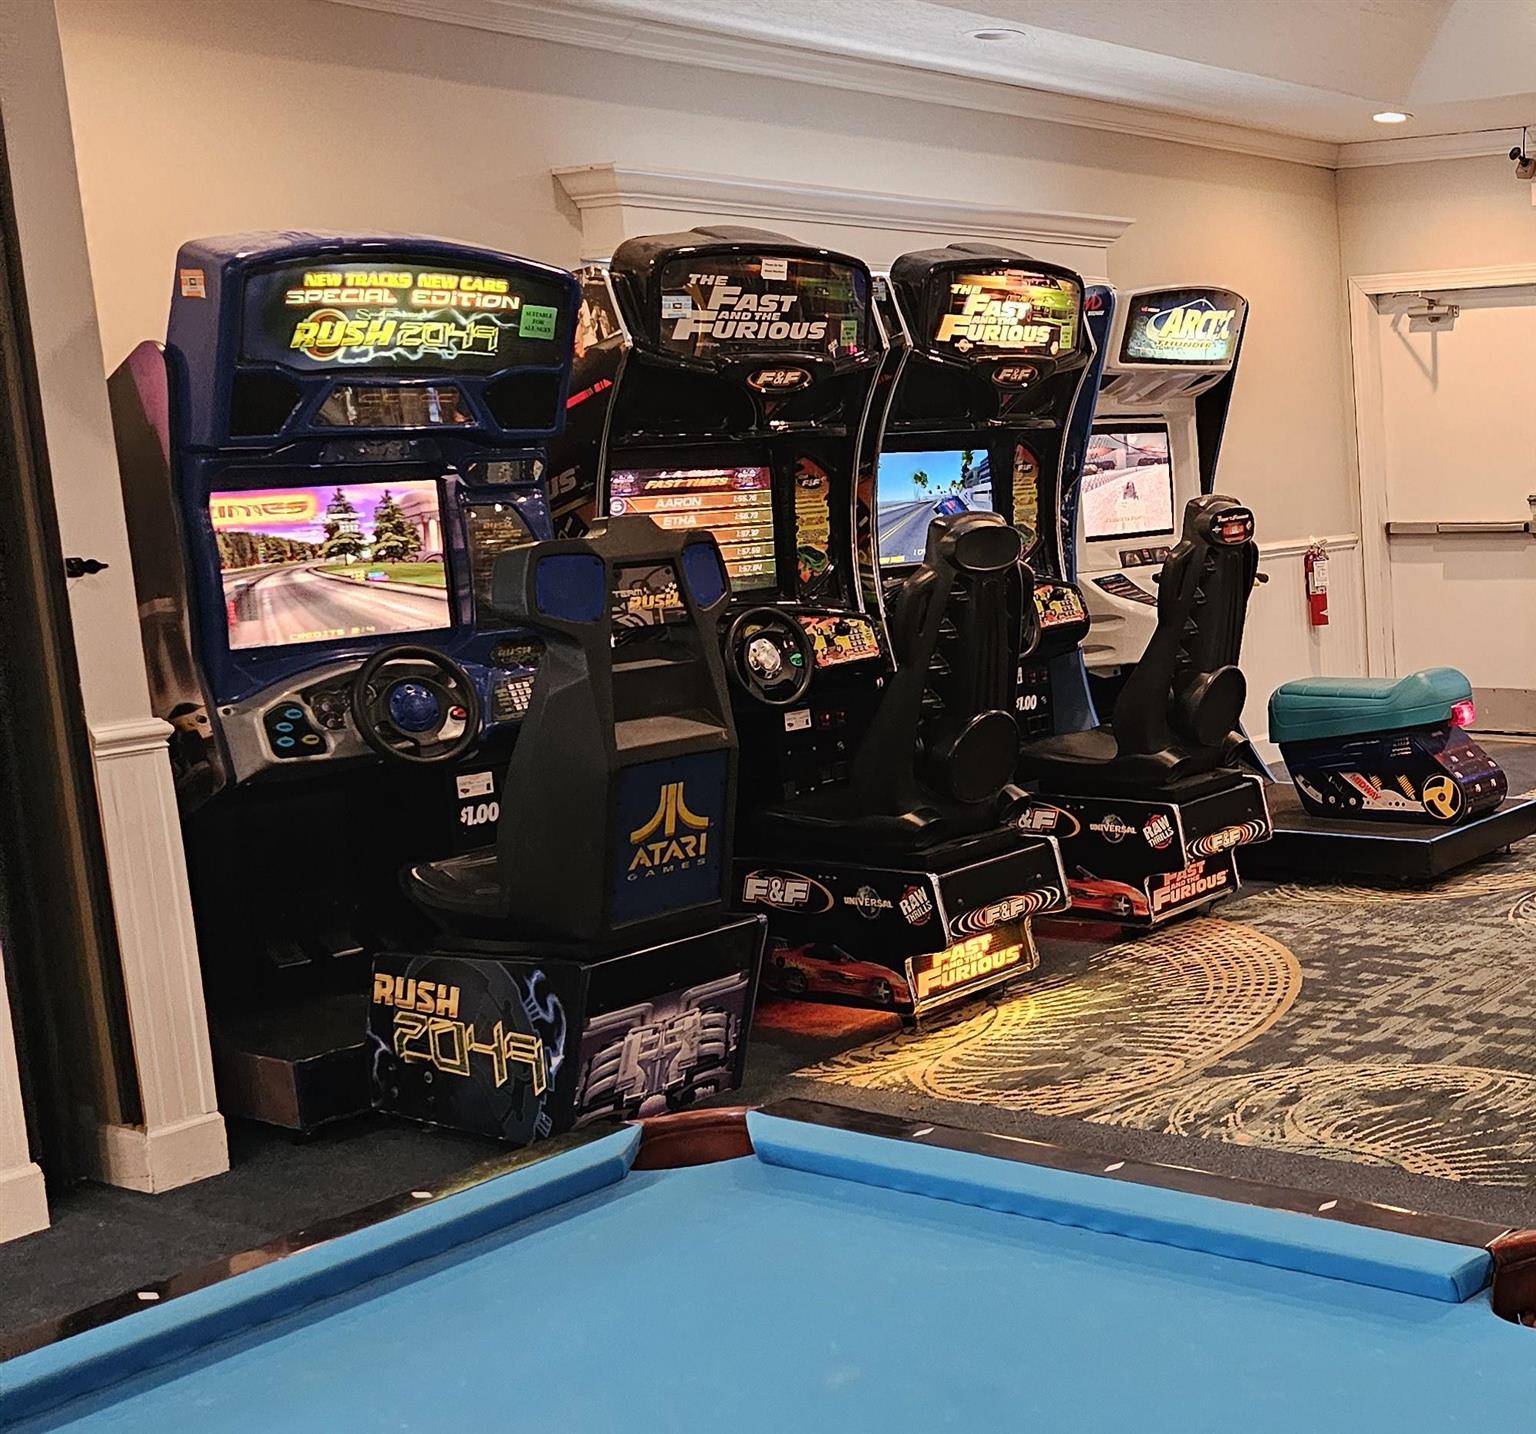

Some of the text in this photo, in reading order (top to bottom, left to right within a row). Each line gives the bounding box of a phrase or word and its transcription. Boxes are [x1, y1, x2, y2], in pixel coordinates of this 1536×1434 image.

[304, 273, 509, 293] NEW TRACKS NEW CARS
[688, 273, 729, 286] THE
[950, 284, 982, 295] THE
[285, 288, 398, 305] SPECIAL
[706, 286, 798, 313] FAST
[961, 293, 1032, 320] FAST
[671, 309, 828, 341] FURIOUS
[717, 311, 781, 321] AND THE
[935, 313, 1051, 342] FURIOUS
[290, 319, 398, 349] RUSH
[756, 369, 802, 387] F&F
[999, 368, 1033, 382] F&F
[644, 479, 684, 490] FAST
[685, 477, 729, 488] TIMES
[655, 497, 702, 509] AARON
[663, 515, 697, 527] ETHA
[629, 593, 681, 611] RUSH
[1350, 772, 1381, 801] MIDWAY
[460, 801, 500, 826] $1.00
[1017, 808, 1059, 830] &F
[1142, 814, 1170, 841] RAW
[1148, 827, 1175, 849] THRILLS
[628, 832, 708, 872] ATARI
[627, 858, 708, 881] GAMES
[1163, 860, 1206, 885] FAST
[743, 874, 811, 905] F&F
[843, 895, 894, 909] UNIVERSAL
[899, 886, 928, 913] RAW
[1153, 868, 1229, 912] FURIOUS
[904, 898, 933, 925] THRILLS
[985, 896, 1027, 927] F&F
[932, 932, 994, 969] FAST
[917, 944, 1023, 997] FURIOUS
[373, 972, 461, 1019] RUSH
[393, 1010, 548, 1097] 2049
